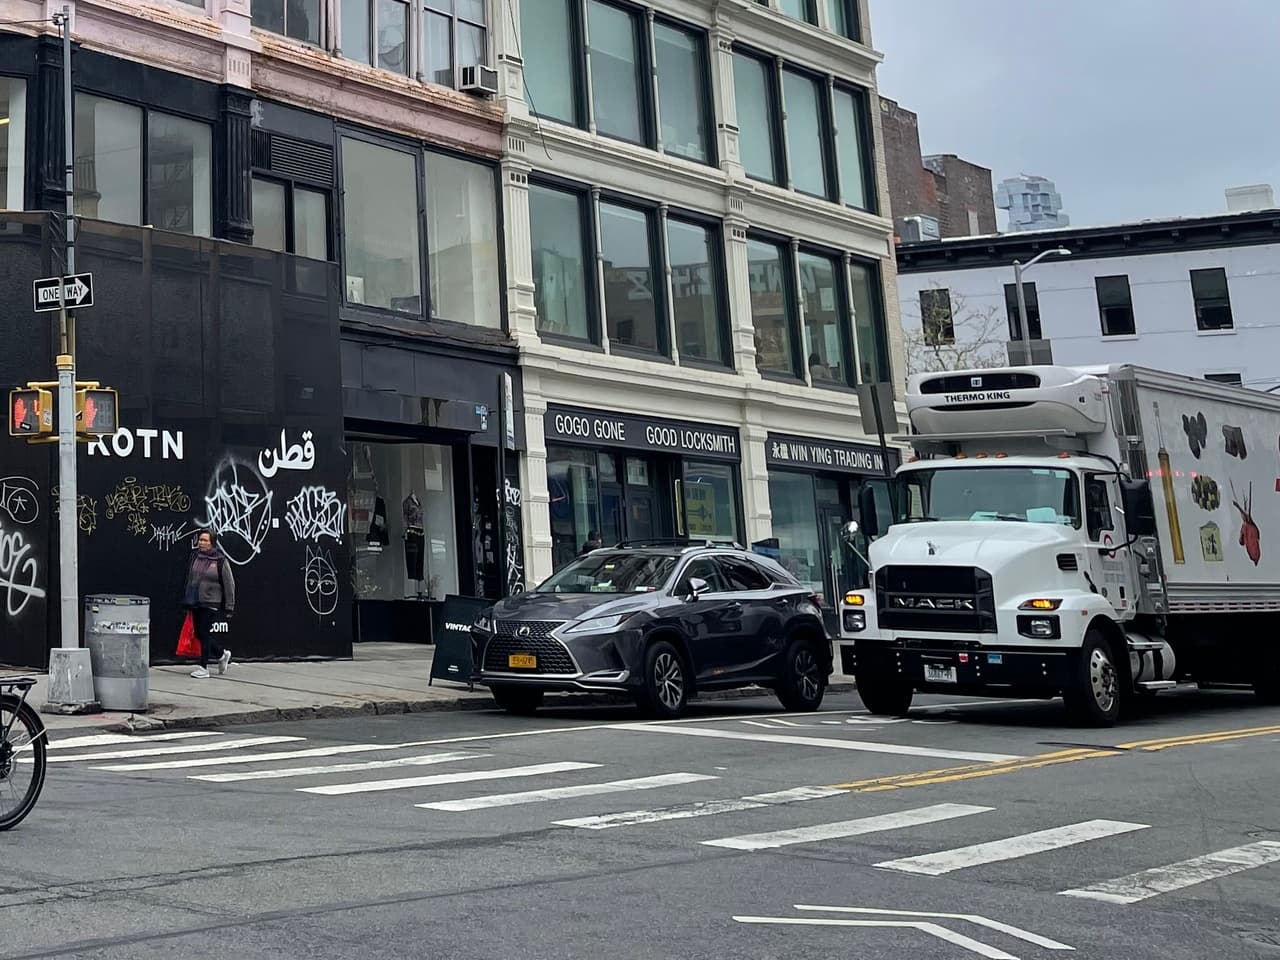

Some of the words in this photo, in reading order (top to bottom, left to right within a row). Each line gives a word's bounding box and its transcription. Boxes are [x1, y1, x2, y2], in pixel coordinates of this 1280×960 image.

[42, 287, 60, 301] ONE
[66, 284, 83, 298] WAY
[944, 393, 985, 403] THERMO
[987, 391, 1010, 400] KING
[556, 414, 590, 436] GOGO
[593, 419, 626, 441] GONE
[646, 425, 678, 447] GOOD
[680, 429, 736, 453] LOCKSMITH
[258, 428, 316, 478] قطن
[789, 443, 808, 461] WIN
[810, 446, 833, 465] YING
[833, 449, 873, 470] TRADING
[873, 454, 884, 471] IN
[894, 598, 974, 609] MACK
